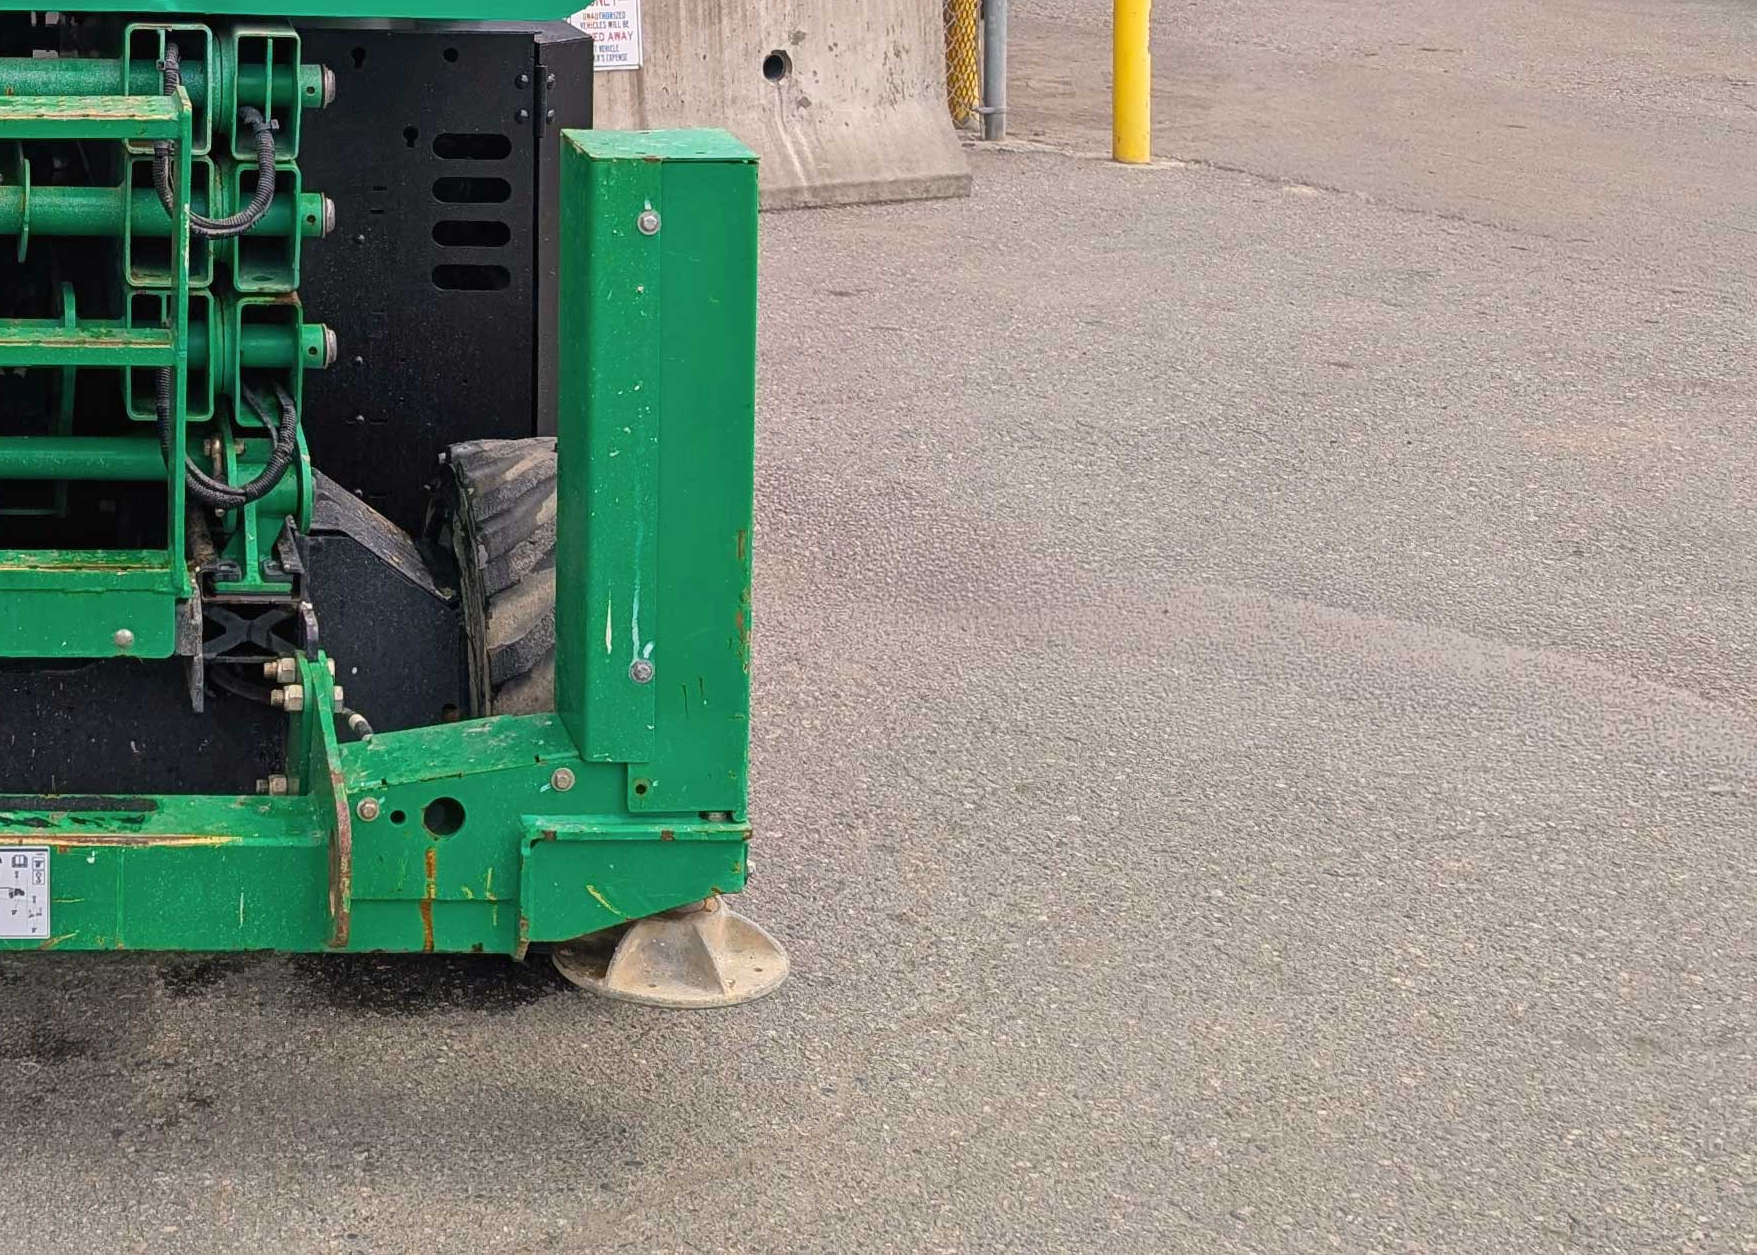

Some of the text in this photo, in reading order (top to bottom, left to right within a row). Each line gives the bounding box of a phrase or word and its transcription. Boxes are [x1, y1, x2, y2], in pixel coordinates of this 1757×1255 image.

[582, 11, 626, 21] UNAUTHORIZED
[580, 20, 629, 29] VEHICLES WILL BE
[608, 31, 633, 42] AWAY
[599, 44, 619, 53] VEHICLE
[606, 53, 628, 62] EXPENSE
